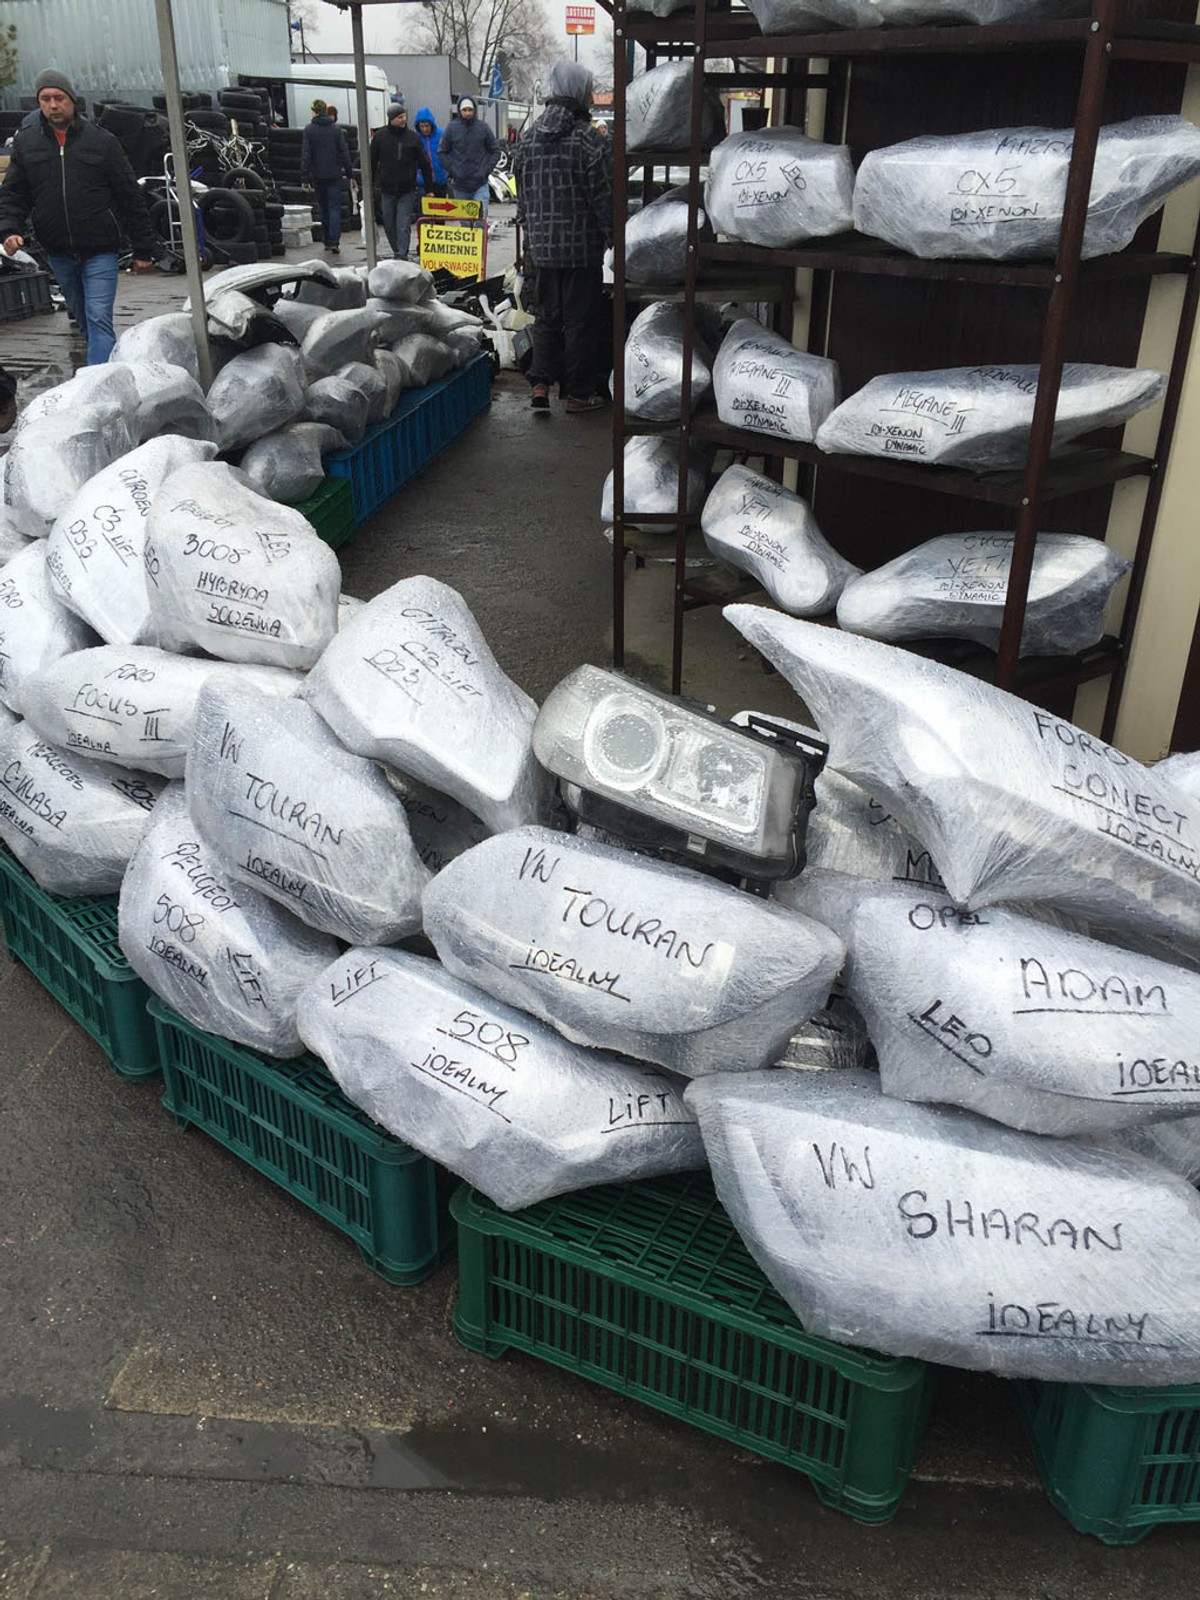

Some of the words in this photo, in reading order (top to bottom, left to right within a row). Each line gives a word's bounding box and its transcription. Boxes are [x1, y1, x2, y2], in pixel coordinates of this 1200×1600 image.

[734, 160, 769, 182] CX5
[955, 165, 1024, 193] CX5
[424, 242, 478, 257] ZAMIENNE
[426, 229, 476, 243] CZĘŚCI
[423, 259, 479, 273] VOLKSWAGEN
[730, 361, 782, 381] MEGANE
[968, 366, 1037, 395] RENAUL
[892, 387, 957, 417] MEGANE
[93, 505, 126, 533] C3
[735, 494, 773, 523] YETI
[67, 519, 98, 560] DS3
[946, 554, 1006, 577] YETI
[196, 570, 269, 603] HYBRYDA
[104, 663, 156, 683] FORD
[367, 649, 420, 685] DS3
[73, 683, 138, 717] FOCUS
[219, 721, 245, 764] VW
[1033, 711, 1130, 766] FORD
[26, 741, 85, 791] MERCEDES
[246, 772, 346, 846] TOURAN
[1063, 763, 1189, 835] CONECT
[161, 842, 241, 914] PEUGEOT
[518, 847, 560, 883] VW
[153, 892, 205, 943] 508
[563, 886, 714, 968] TOURAN
[908, 903, 990, 930] OPEL
[1019, 957, 1168, 1010] ADAM
[450, 1010, 531, 1062] 508
[919, 999, 993, 1058] LED
[812, 1141, 876, 1190] VW
[897, 1189, 1123, 1252] SHARAN
